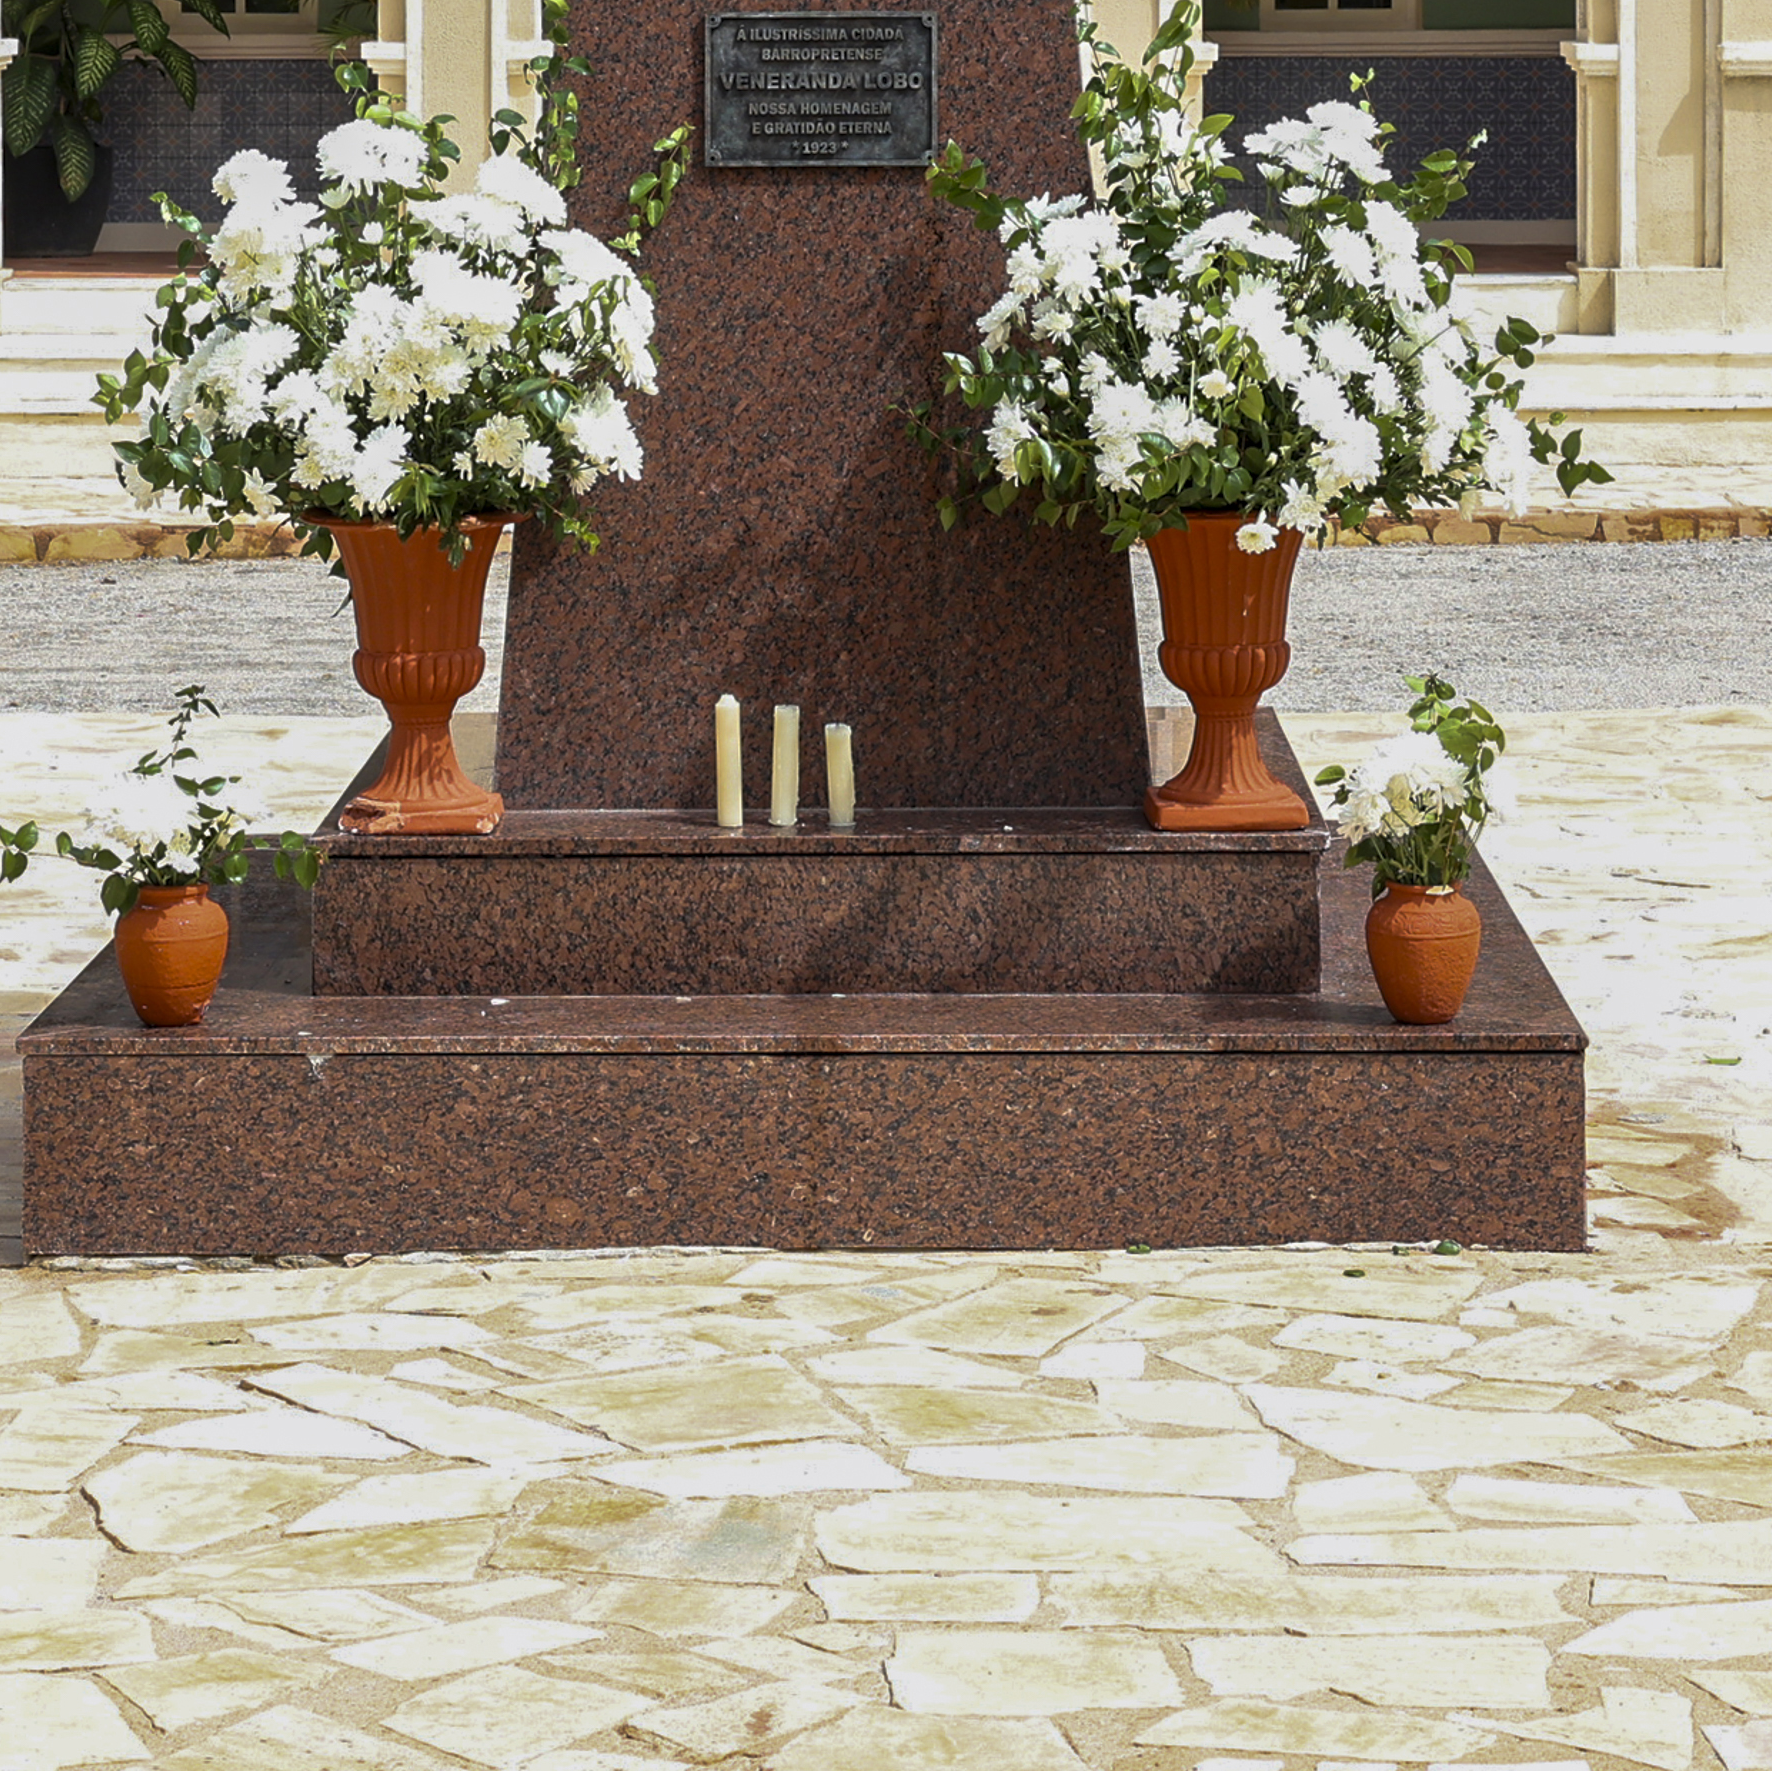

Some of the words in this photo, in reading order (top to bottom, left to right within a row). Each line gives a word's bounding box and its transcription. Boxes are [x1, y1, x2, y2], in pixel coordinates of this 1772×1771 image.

[750, 25, 849, 41] ILUSTRÍSSIMA
[761, 47, 883, 62] BARROPRETENSE
[720, 72, 858, 90] VENERANDA
[863, 72, 925, 91] LOBO
[748, 102, 797, 116] NOSSA
[800, 101, 893, 116] HOMENAGEM
[752, 122, 761, 134] E
[764, 118, 835, 135] GRATIDÃO
[838, 122, 893, 135] ETERNA
[802, 141, 838, 155] 1923
